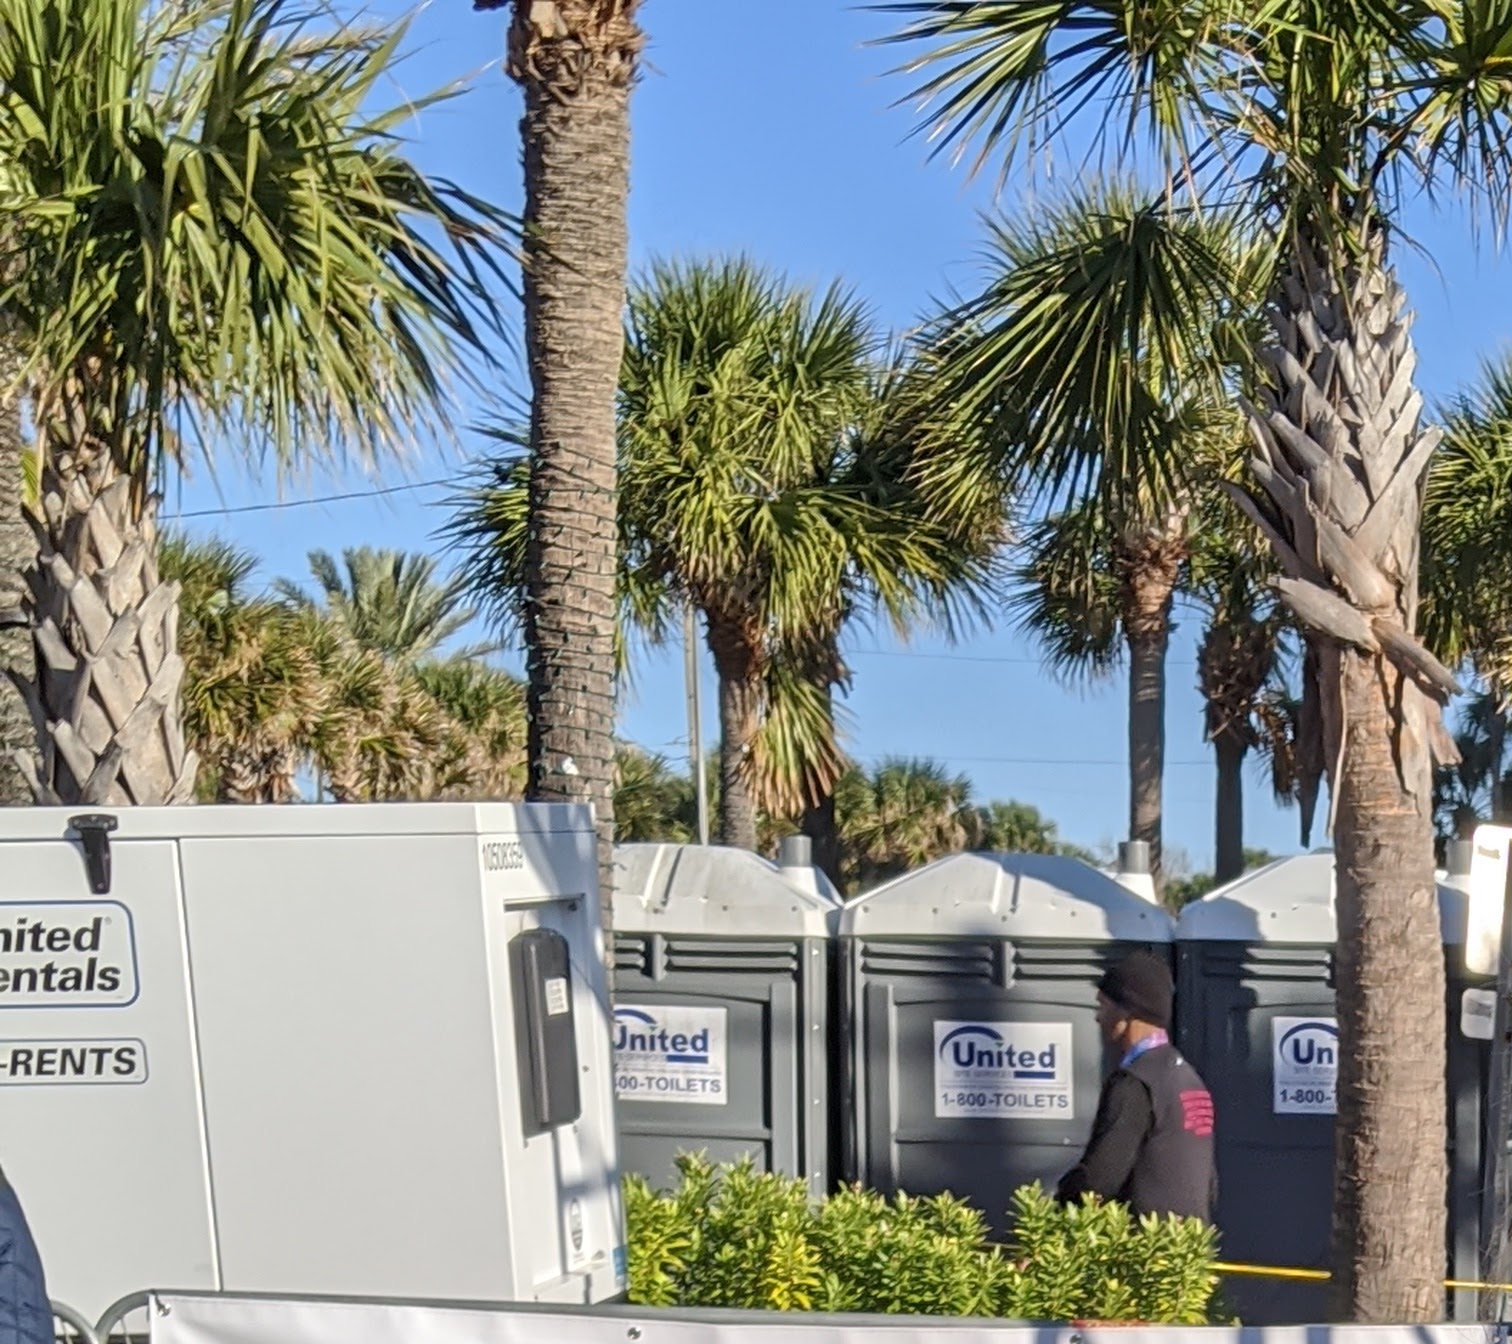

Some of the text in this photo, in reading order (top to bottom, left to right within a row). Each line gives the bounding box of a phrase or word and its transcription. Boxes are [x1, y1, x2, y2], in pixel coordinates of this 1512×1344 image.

[953, 1042, 1055, 1068] United
[615, 1076, 722, 1093] 00-TOILETS
[942, 1092, 1068, 1108] 1-800-TOILETS
